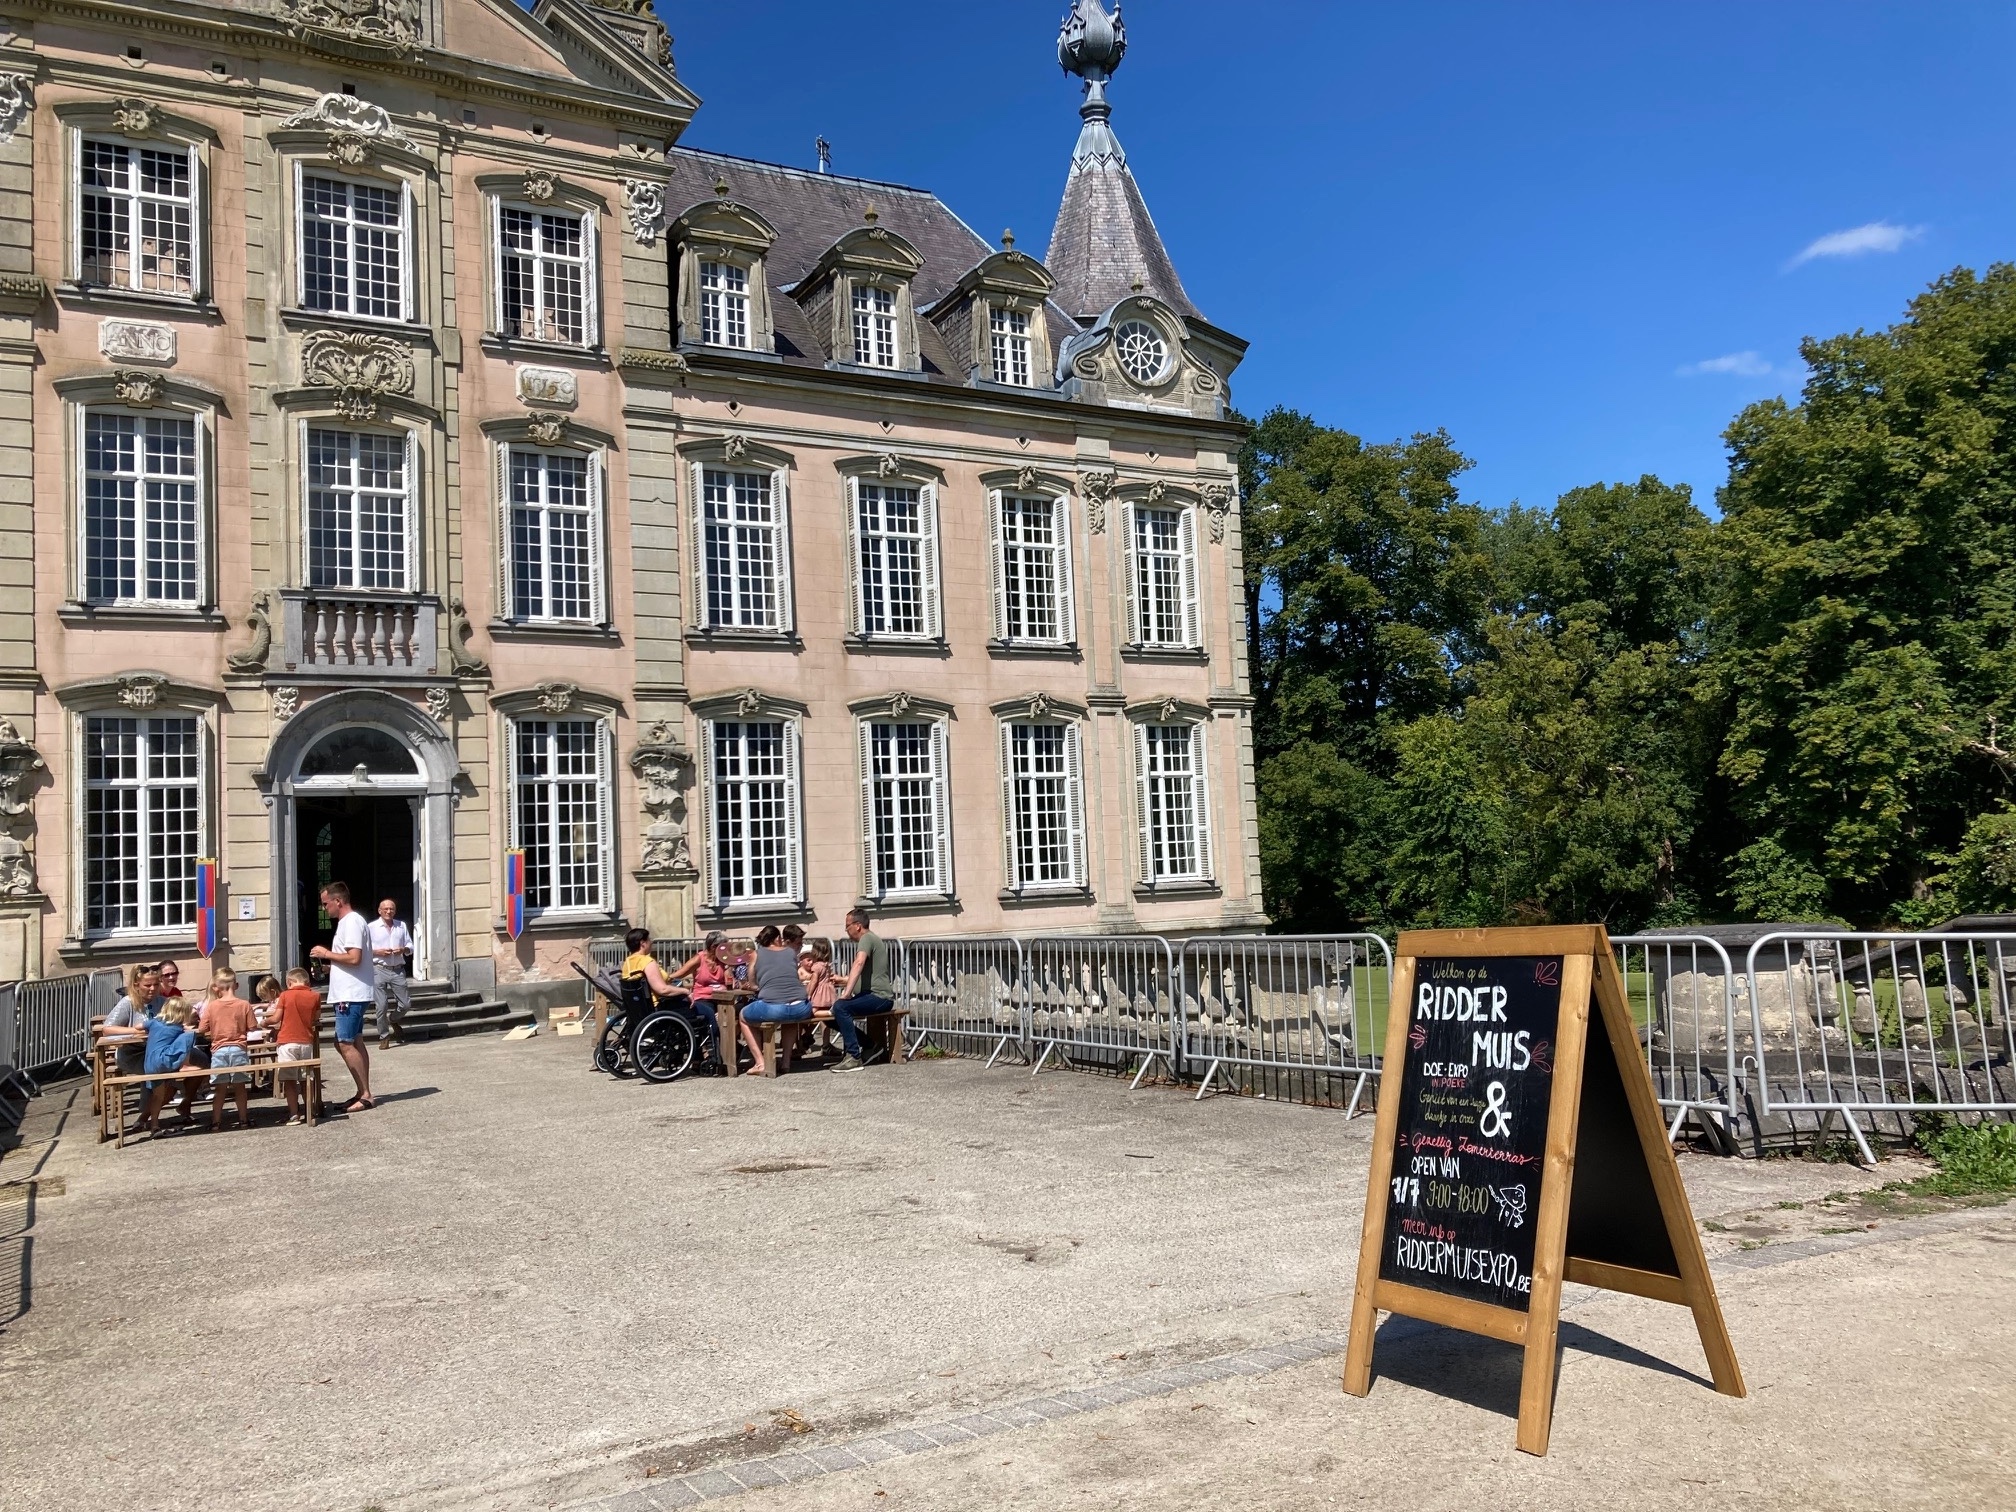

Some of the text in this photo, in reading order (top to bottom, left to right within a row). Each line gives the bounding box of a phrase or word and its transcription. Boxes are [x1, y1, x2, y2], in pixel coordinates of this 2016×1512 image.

[106, 326, 171, 351] ANNO
[1432, 961, 1488, 983] Welkom op de
[1416, 982, 1508, 1022] RIDDER
[1472, 1030, 1531, 1071] MUIS
[1431, 1077, 1466, 1088] IN POEKE
[1479, 1080, 1512, 1138] &
[1411, 1156, 1461, 1179] OPEN VAN
[1392, 1176, 1420, 1207] 7/7
[1402, 1218, 1456, 1245] meer info op
[1396, 1235, 1532, 1293] RIDDERMUISEXPO.BE
